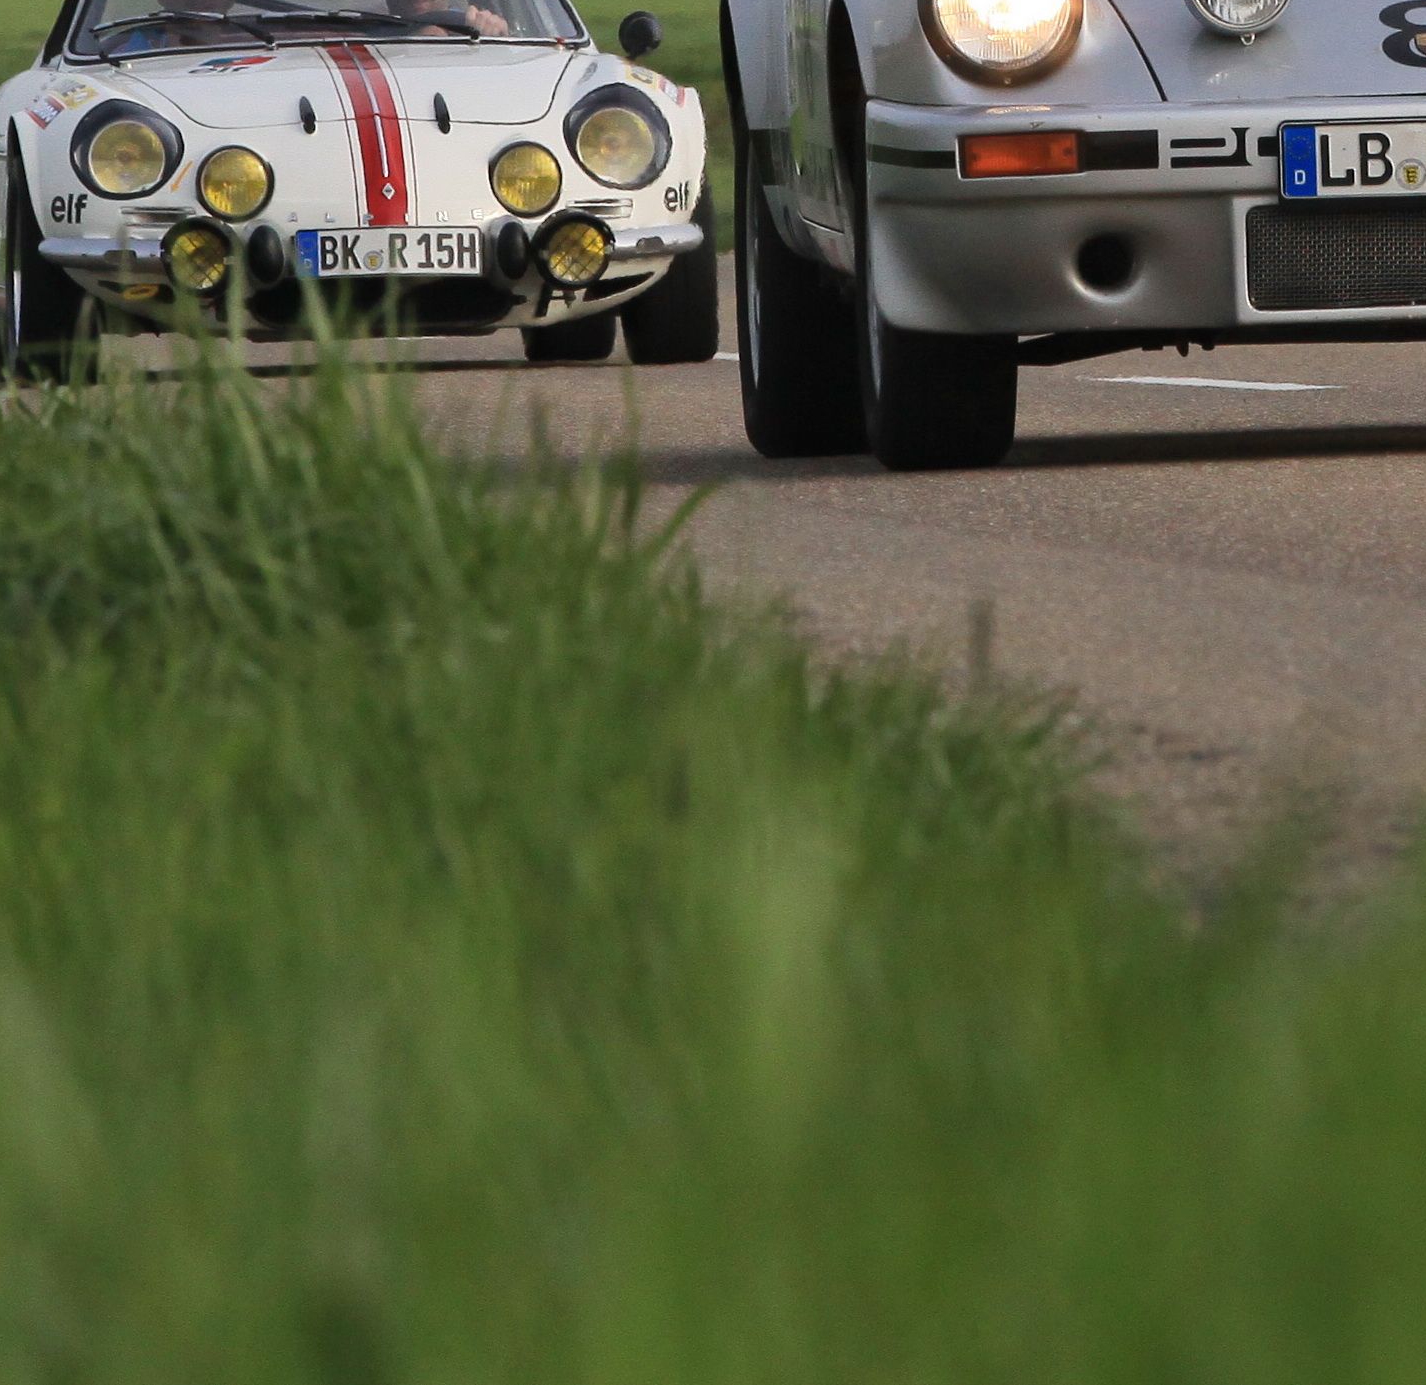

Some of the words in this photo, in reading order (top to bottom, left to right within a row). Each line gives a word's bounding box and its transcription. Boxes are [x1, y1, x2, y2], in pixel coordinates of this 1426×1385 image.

[1320, 132, 1394, 187] LB
[1294, 169, 1306, 185] D
[51, 193, 88, 224] elf
[663, 181, 690, 212] elf
[320, 235, 361, 270] BK
[388, 233, 408, 268] R
[417, 233, 477, 269] 15H
